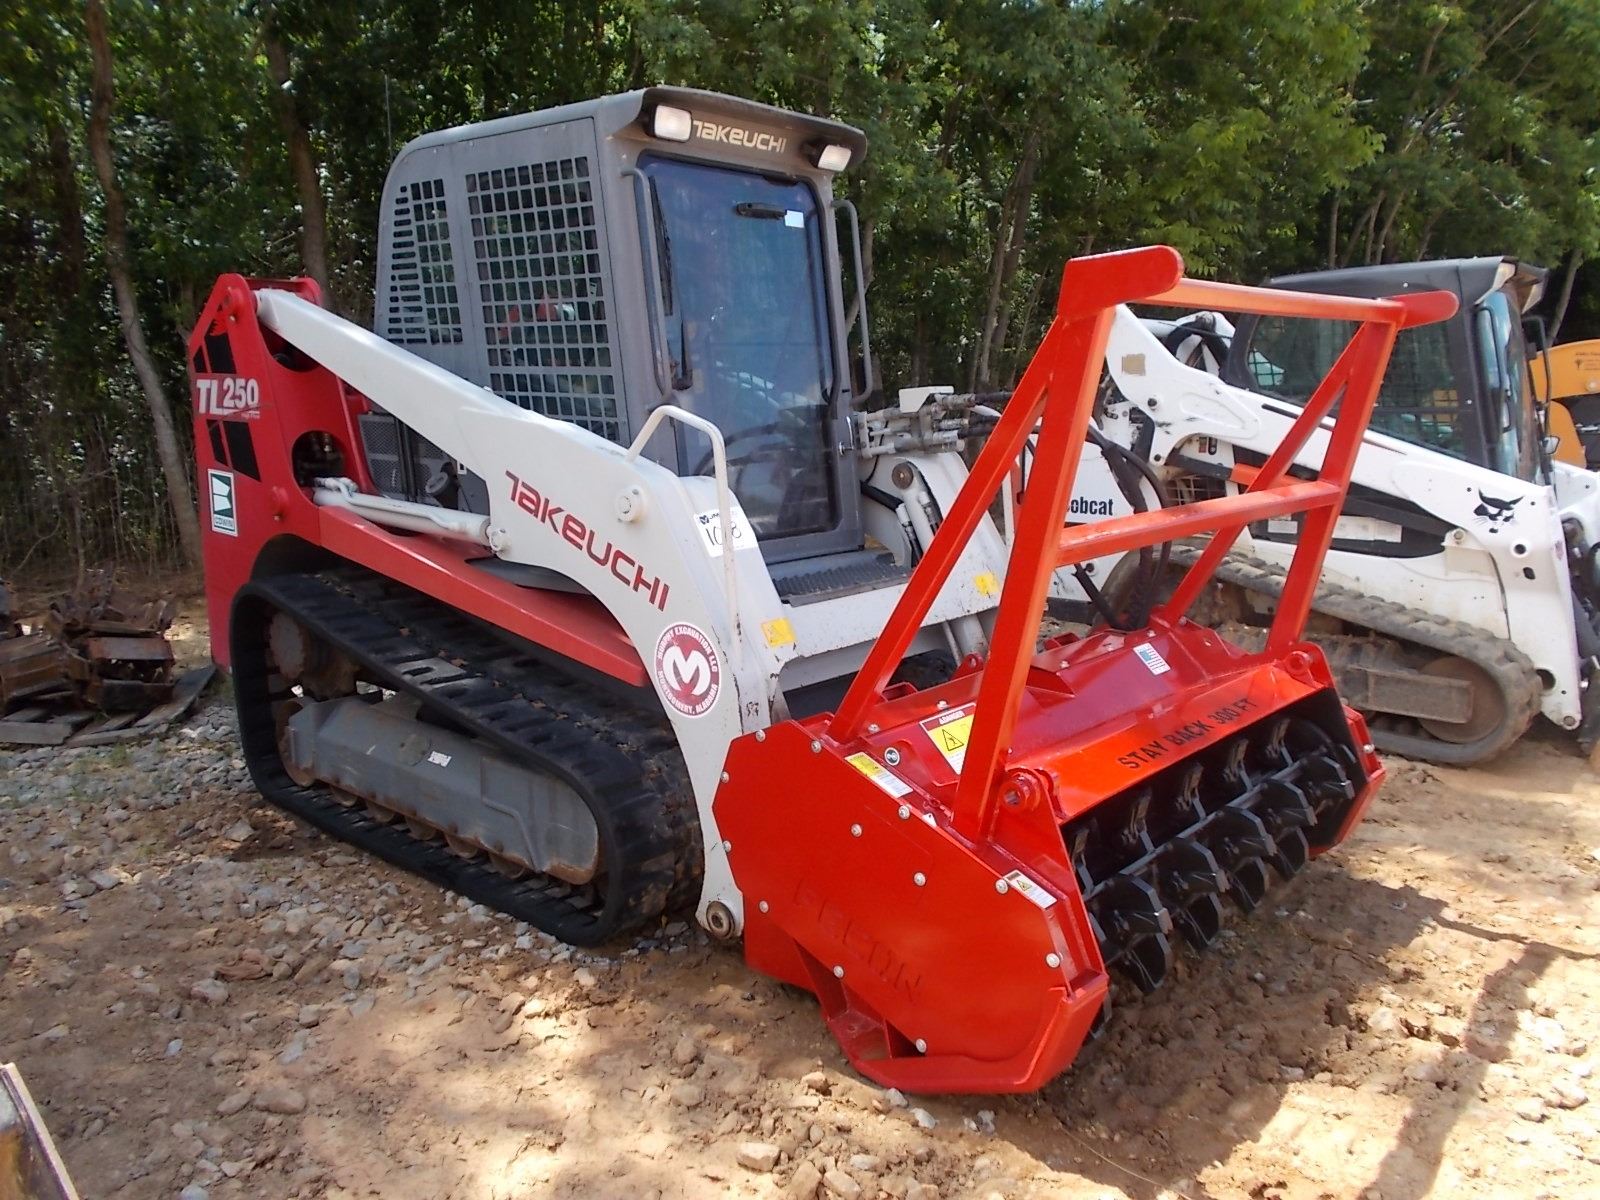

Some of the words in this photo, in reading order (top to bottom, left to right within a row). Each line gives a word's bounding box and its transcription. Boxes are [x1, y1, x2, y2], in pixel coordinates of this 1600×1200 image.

[196, 377, 260, 416] TL250
[1067, 496, 1114, 516] obcat
[674, 626, 713, 655] EXCAVATION
[708, 654, 718, 673] LLC
[695, 683, 719, 713] ALABAMA
[1118, 740, 1169, 769] STAY
[1163, 720, 1214, 746] BACK
[1208, 707, 1239, 725] 300
[1236, 698, 1257, 712] FT
